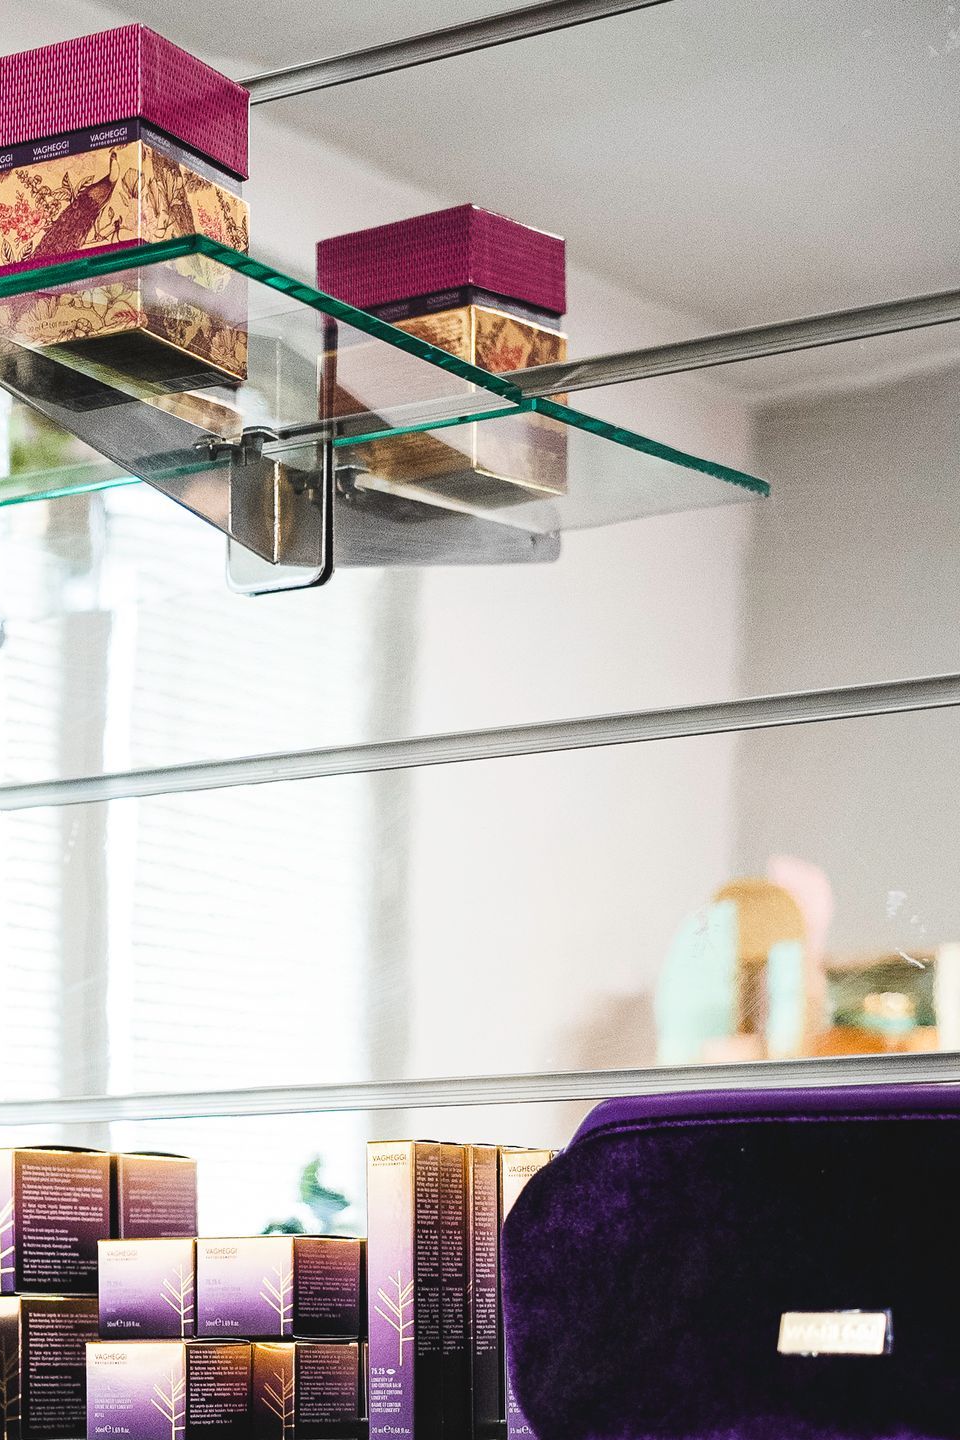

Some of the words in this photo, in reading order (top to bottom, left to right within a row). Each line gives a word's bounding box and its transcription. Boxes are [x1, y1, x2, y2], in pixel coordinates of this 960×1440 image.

[33, 140, 69, 155] VAGHEGGI
[90, 127, 127, 142] VAGHEGGI
[508, 1165, 541, 1173] VAGHEGG
